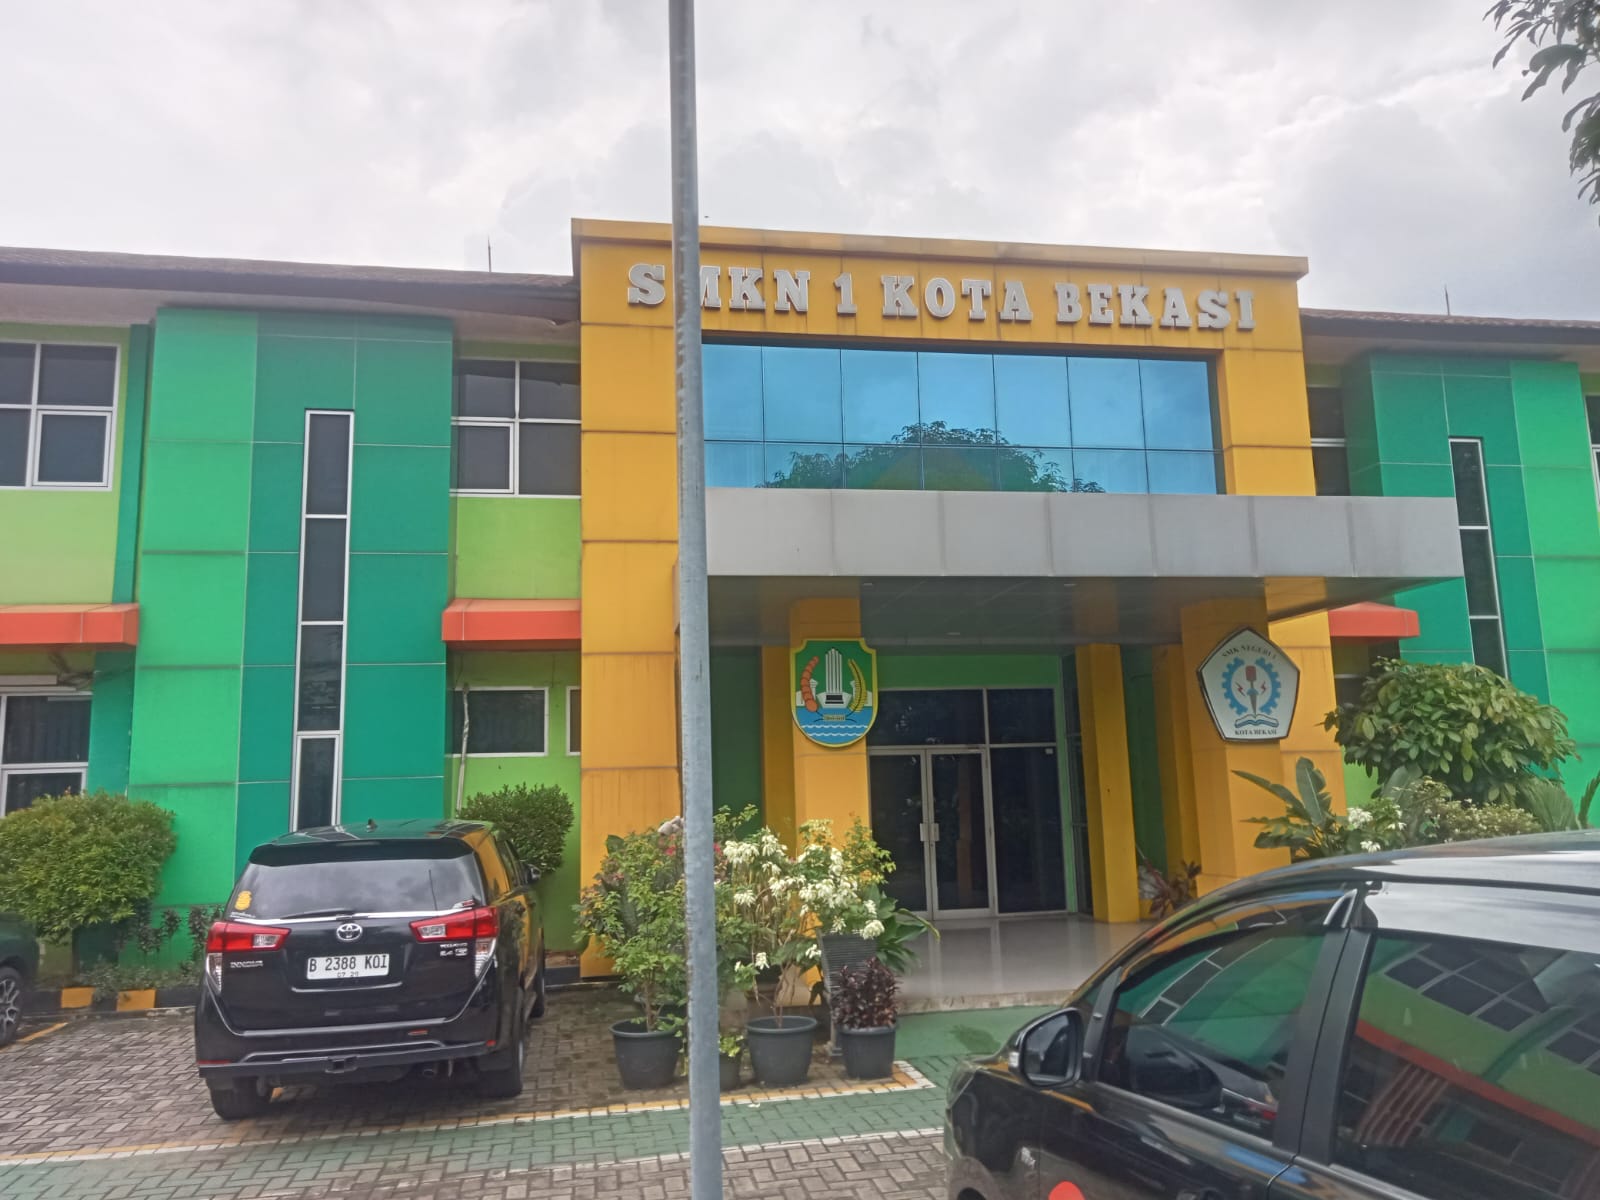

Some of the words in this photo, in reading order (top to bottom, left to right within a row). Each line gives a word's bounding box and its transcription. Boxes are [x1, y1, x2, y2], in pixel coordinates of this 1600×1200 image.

[833, 272, 857, 314] 1
[881, 275, 1033, 320] KOTA
[1055, 282, 1256, 329] BEKASI
[309, 958, 317, 973] B
[325, 956, 357, 971] 2388
